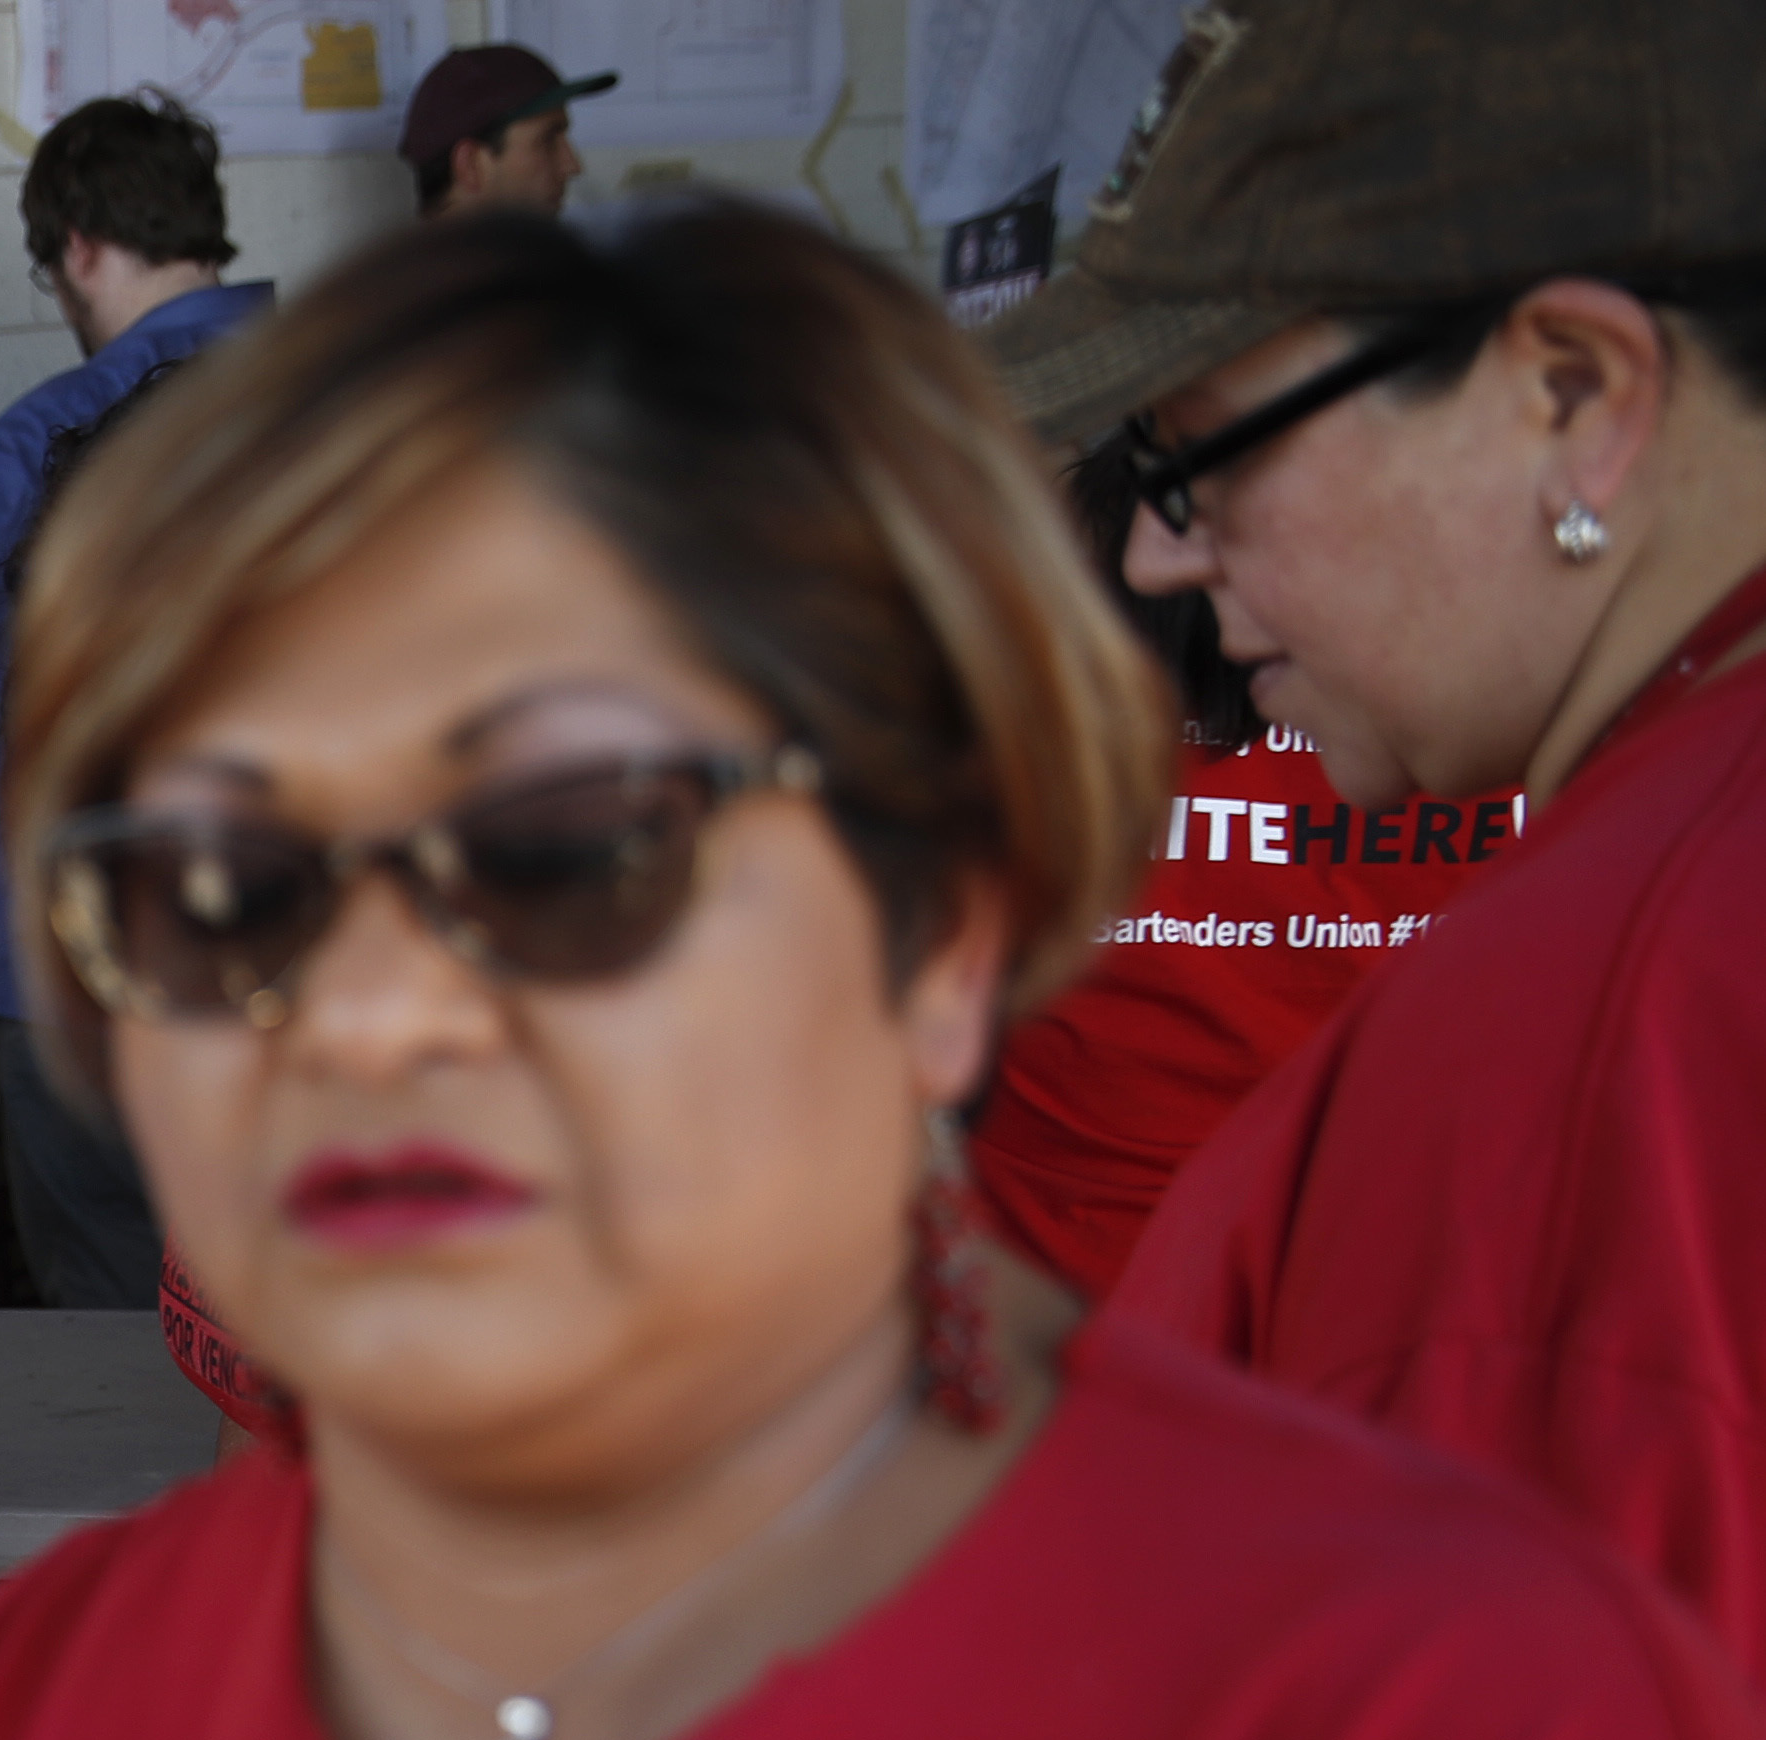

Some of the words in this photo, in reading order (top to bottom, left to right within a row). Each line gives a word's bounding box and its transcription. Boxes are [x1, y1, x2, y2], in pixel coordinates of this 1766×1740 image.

[1150, 793, 1525, 866] ITEHERE!
[1286, 914, 1382, 949] Union
[1389, 914, 1449, 947] #1
